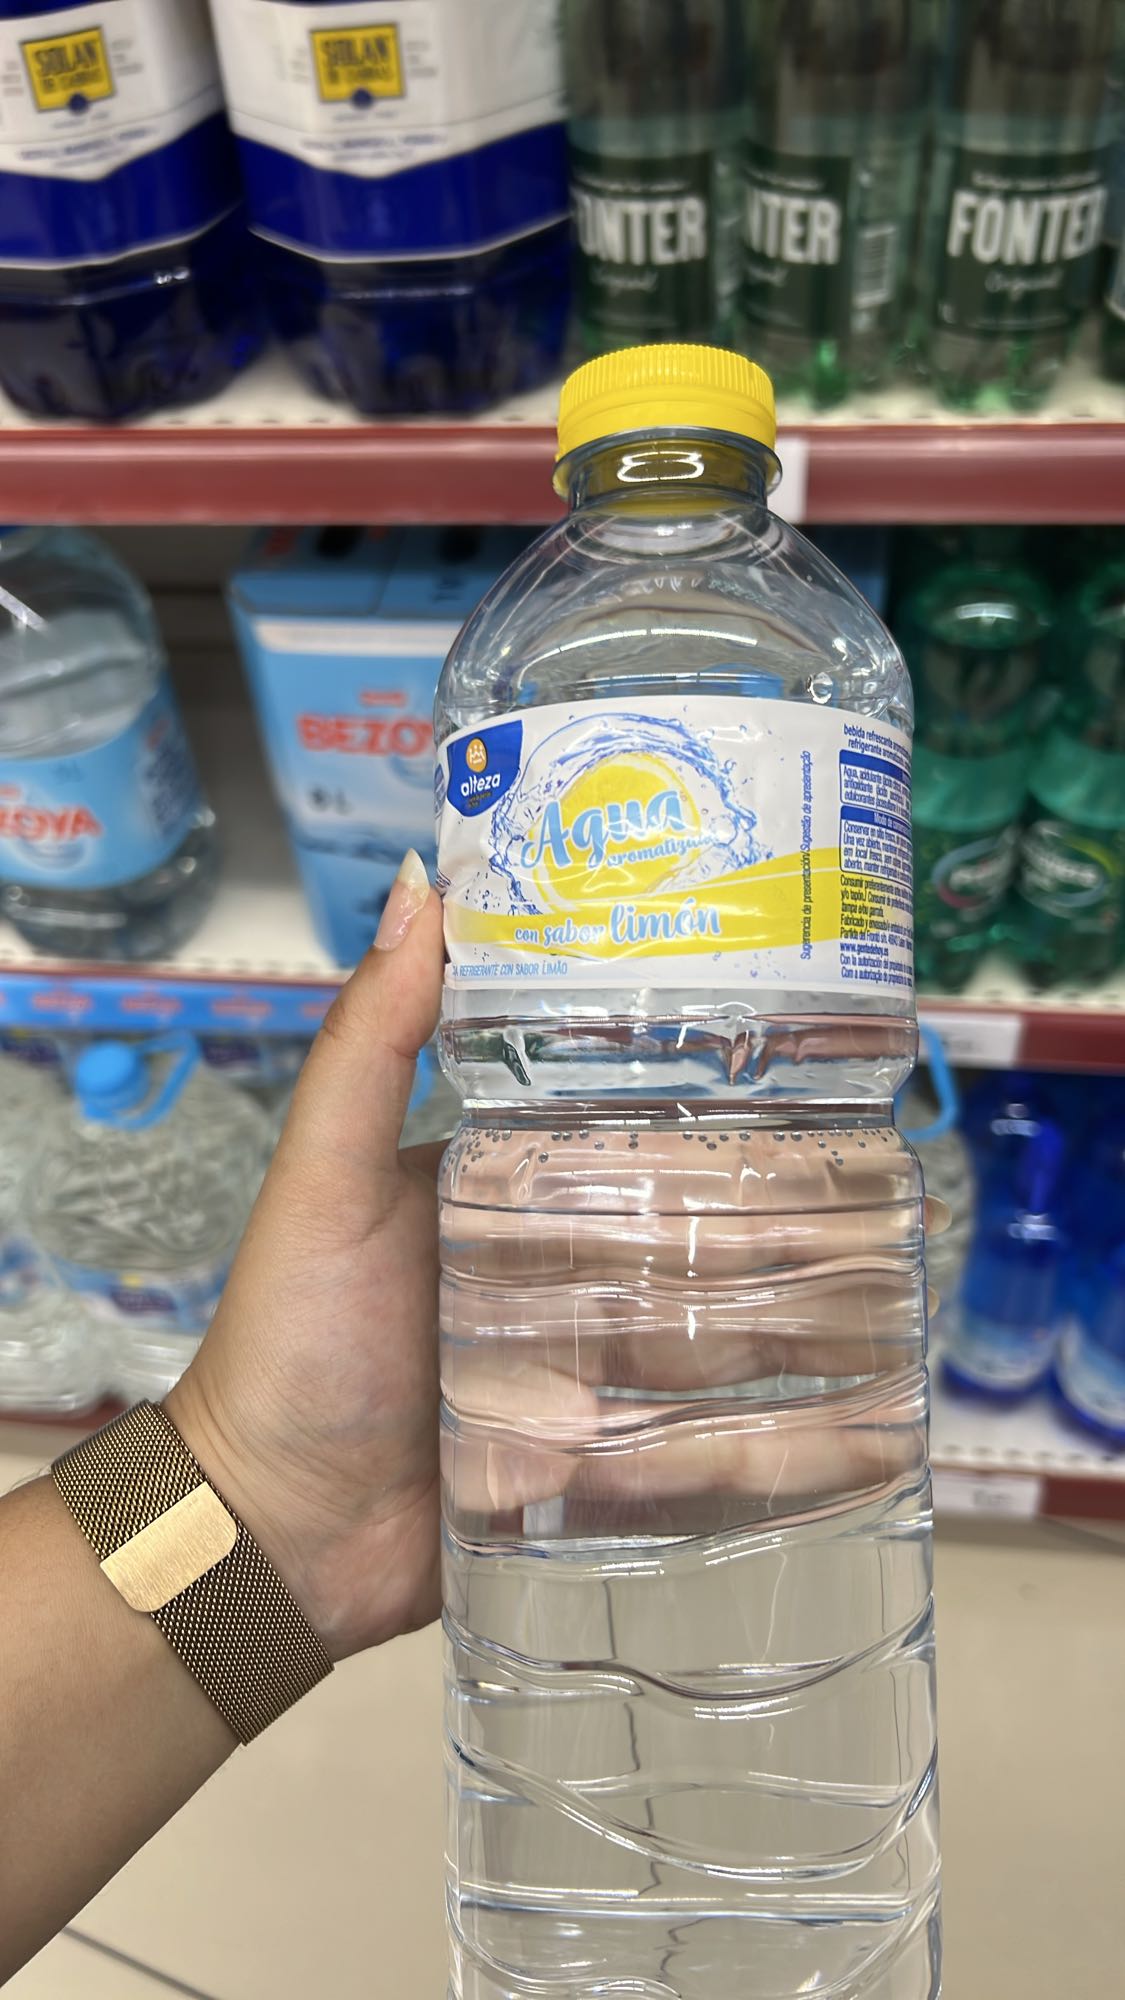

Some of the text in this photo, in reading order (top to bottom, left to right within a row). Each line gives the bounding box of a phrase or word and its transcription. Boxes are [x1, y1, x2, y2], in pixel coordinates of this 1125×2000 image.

[844, 724, 865, 739] bebida
[460, 773, 501, 797] alteza
[801, 803, 812, 814] de
[520, 790, 686, 868] Agua
[801, 904, 812, 915] de
[515, 897, 720, 947] con sabor limón
[800, 916, 813, 960] Sugerencia
[500, 963, 514, 976] CON
[515, 963, 540, 976] SABOR
